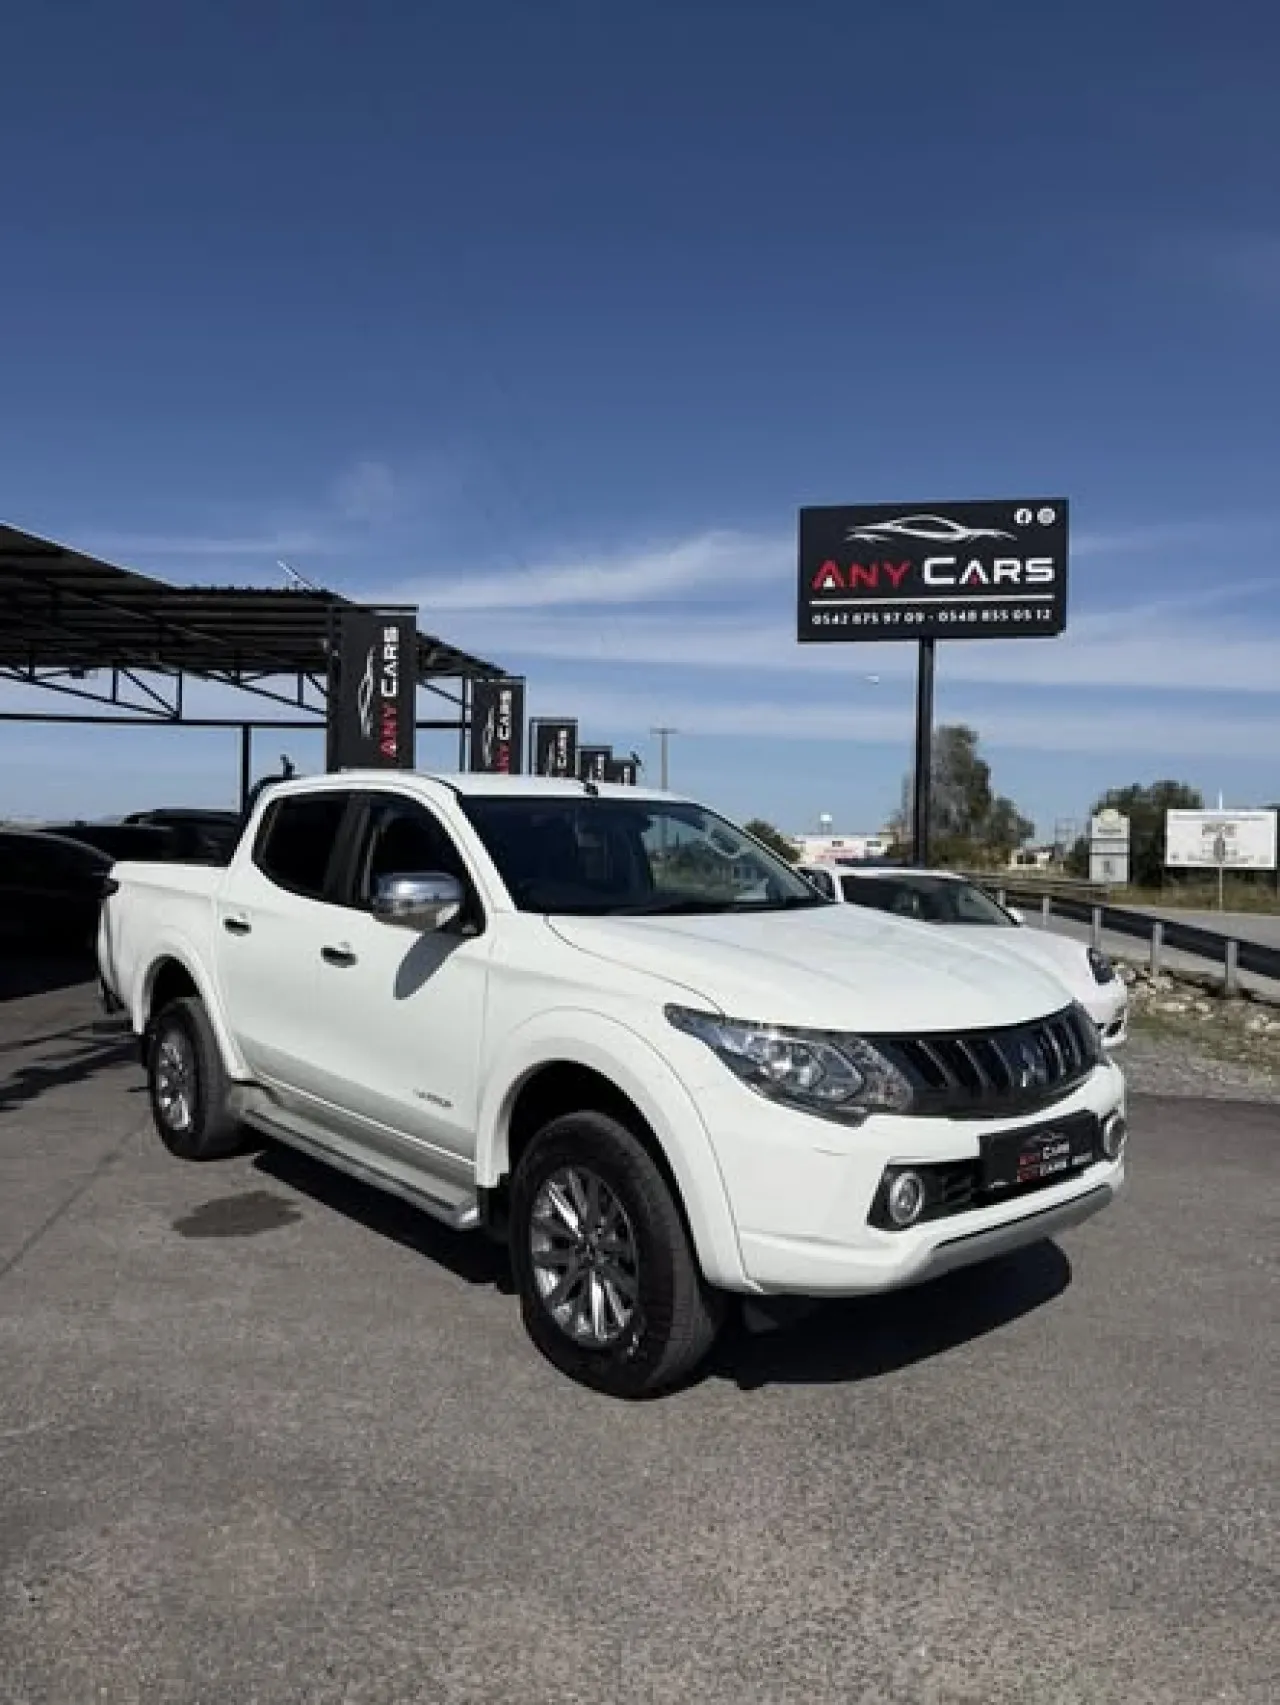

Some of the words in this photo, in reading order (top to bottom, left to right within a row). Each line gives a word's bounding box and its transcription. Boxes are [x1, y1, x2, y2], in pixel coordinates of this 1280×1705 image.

[812, 559, 911, 590] ANY
[922, 556, 1056, 585] CARS
[381, 626, 399, 698] CARS
